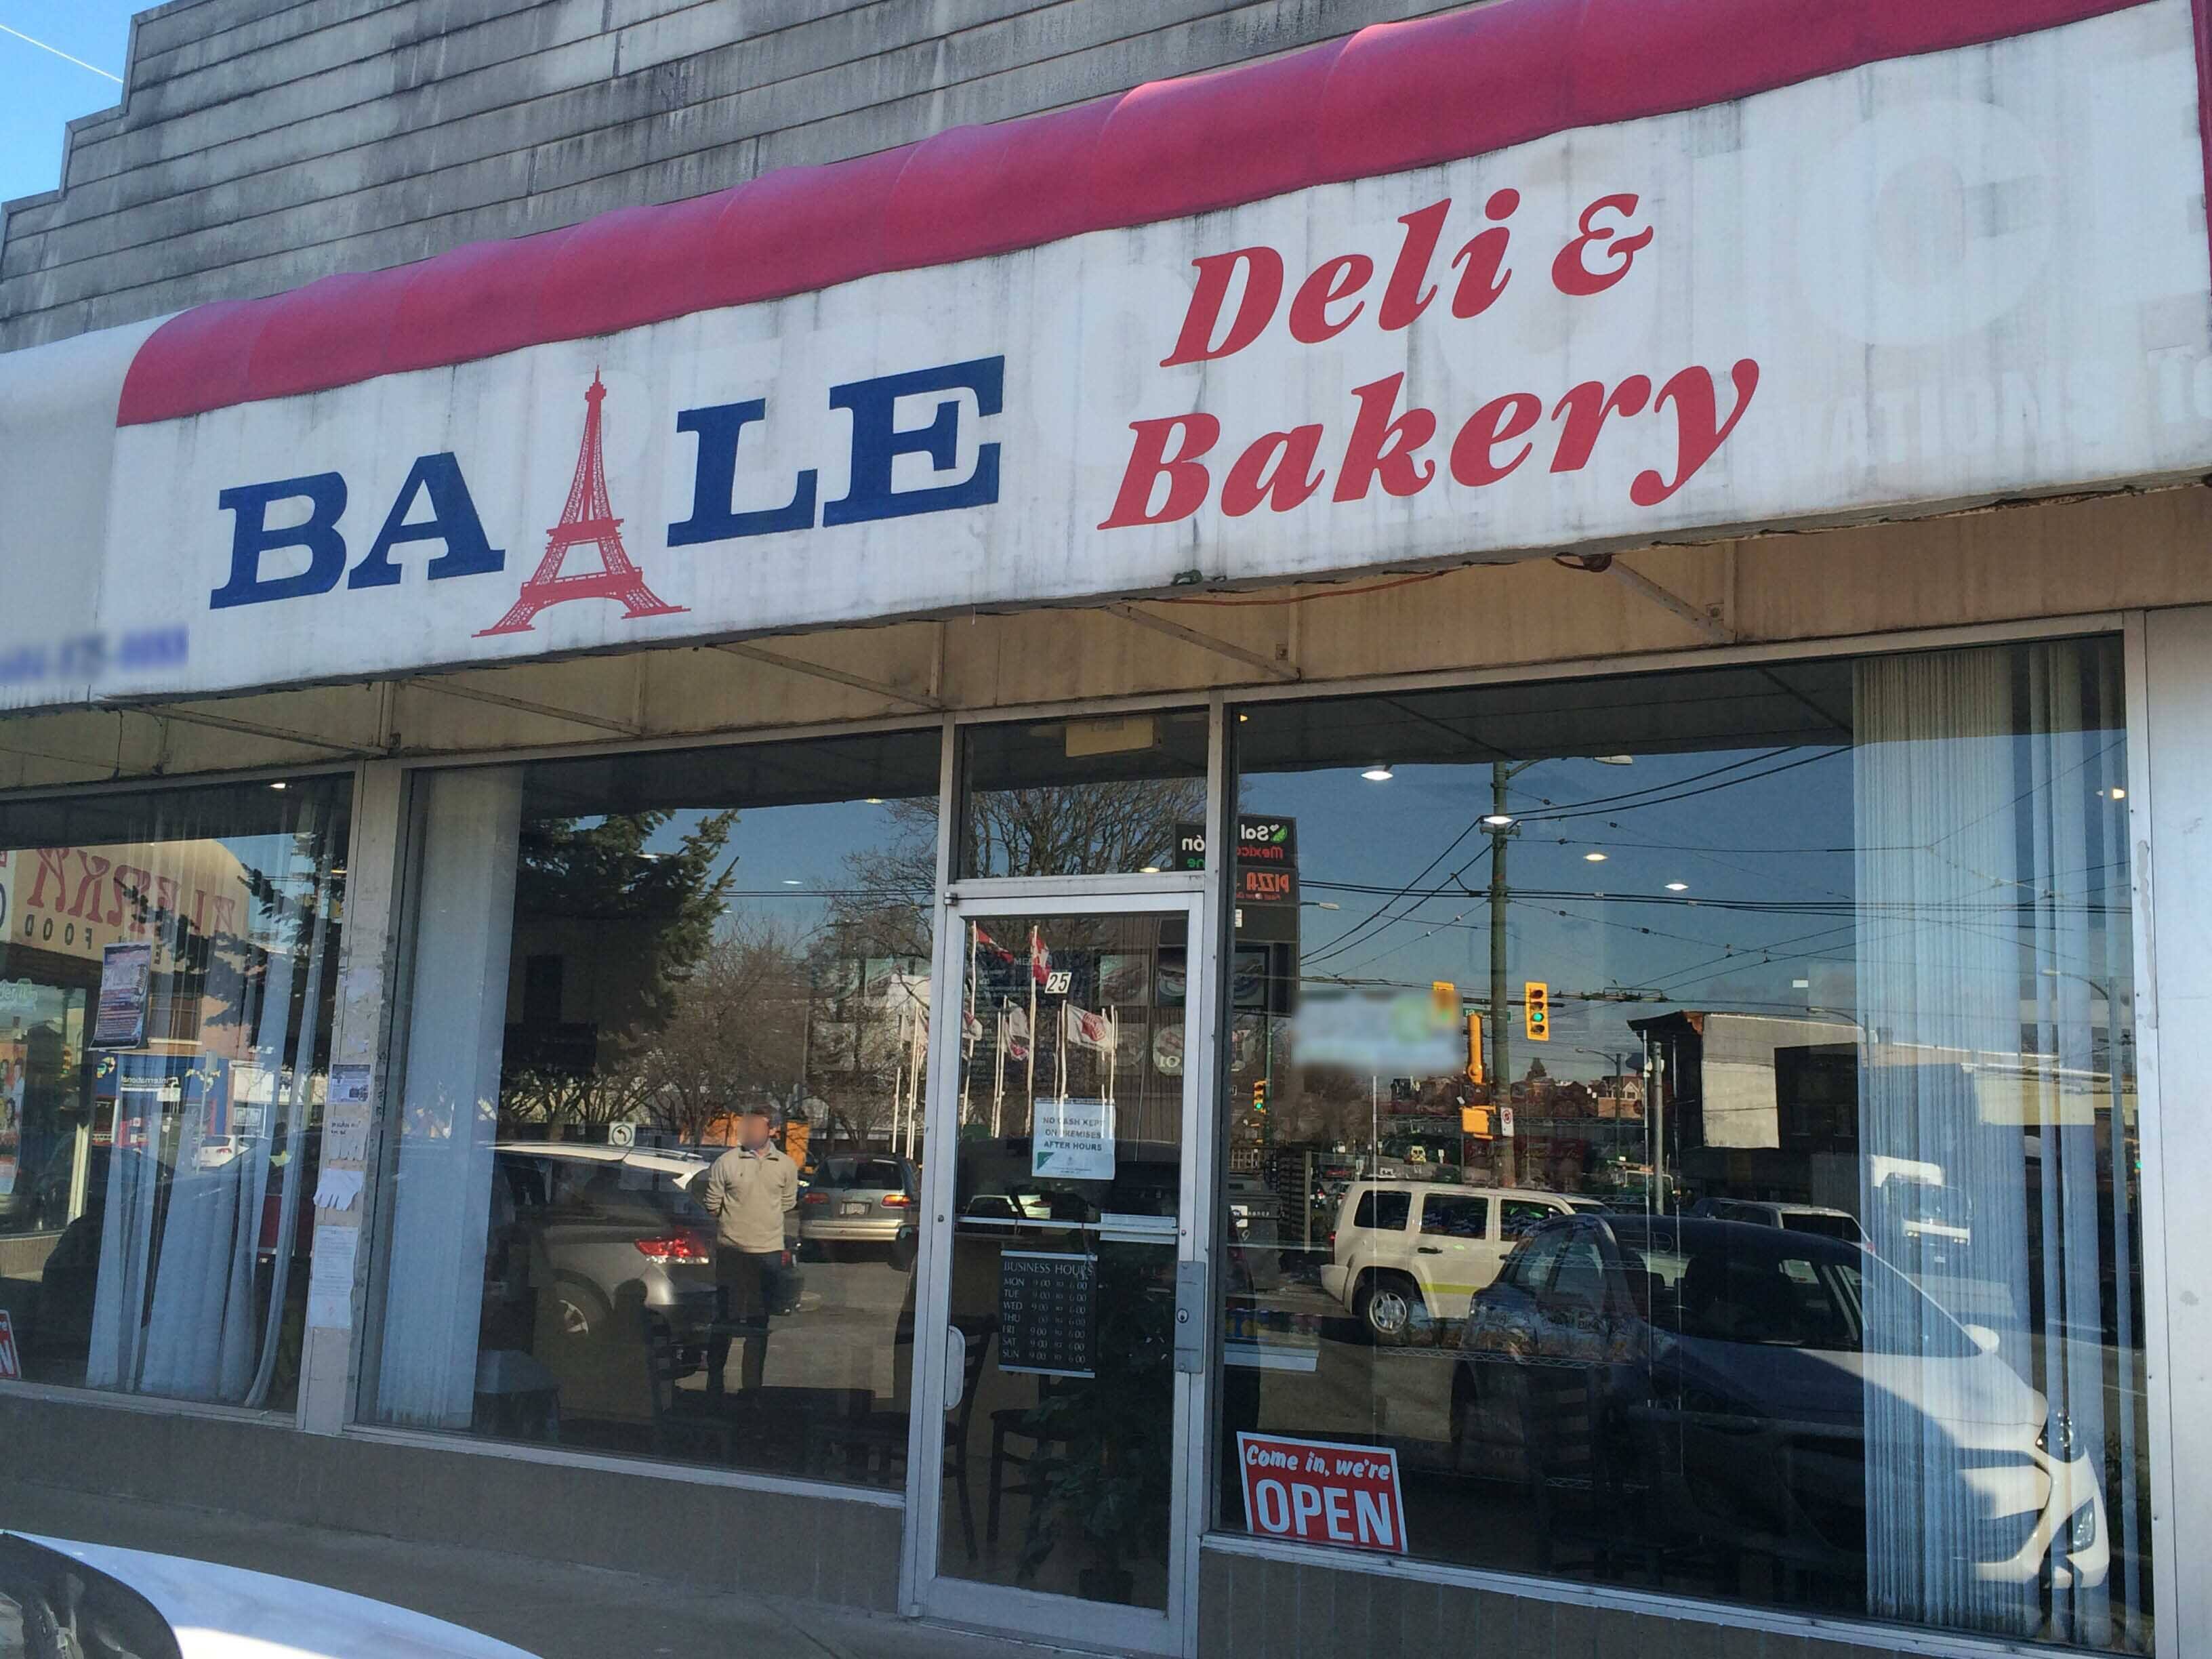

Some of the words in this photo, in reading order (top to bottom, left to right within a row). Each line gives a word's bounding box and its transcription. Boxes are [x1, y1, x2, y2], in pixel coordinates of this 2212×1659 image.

[1160, 188, 1520, 367] Deli
[1551, 192, 1654, 297] &
[1096, 358, 1760, 531] Bakery
[1048, 975, 1069, 991] 25
[1043, 1116, 1055, 1124] NO
[1045, 1128, 1057, 1136] ON
[1044, 1141, 1070, 1149] AFTER
[1073, 1143, 1102, 1151] HOURS
[1003, 1261, 1051, 1274] BUSINESS
[1004, 1277, 1025, 1286] MON
[1004, 1289, 1020, 1298] TUE
[1003, 1301, 1023, 1310] WED
[1003, 1313, 1021, 1322] THU
[1002, 1325, 1015, 1334] FRI
[1002, 1337, 1017, 1347] SAT
[1002, 1349, 1020, 1359] SUN
[1246, 1444, 1299, 1471] Come
[1305, 1451, 1330, 1477] in,
[1335, 1458, 1391, 1481] we're
[1255, 1478, 1394, 1547] OPEN
